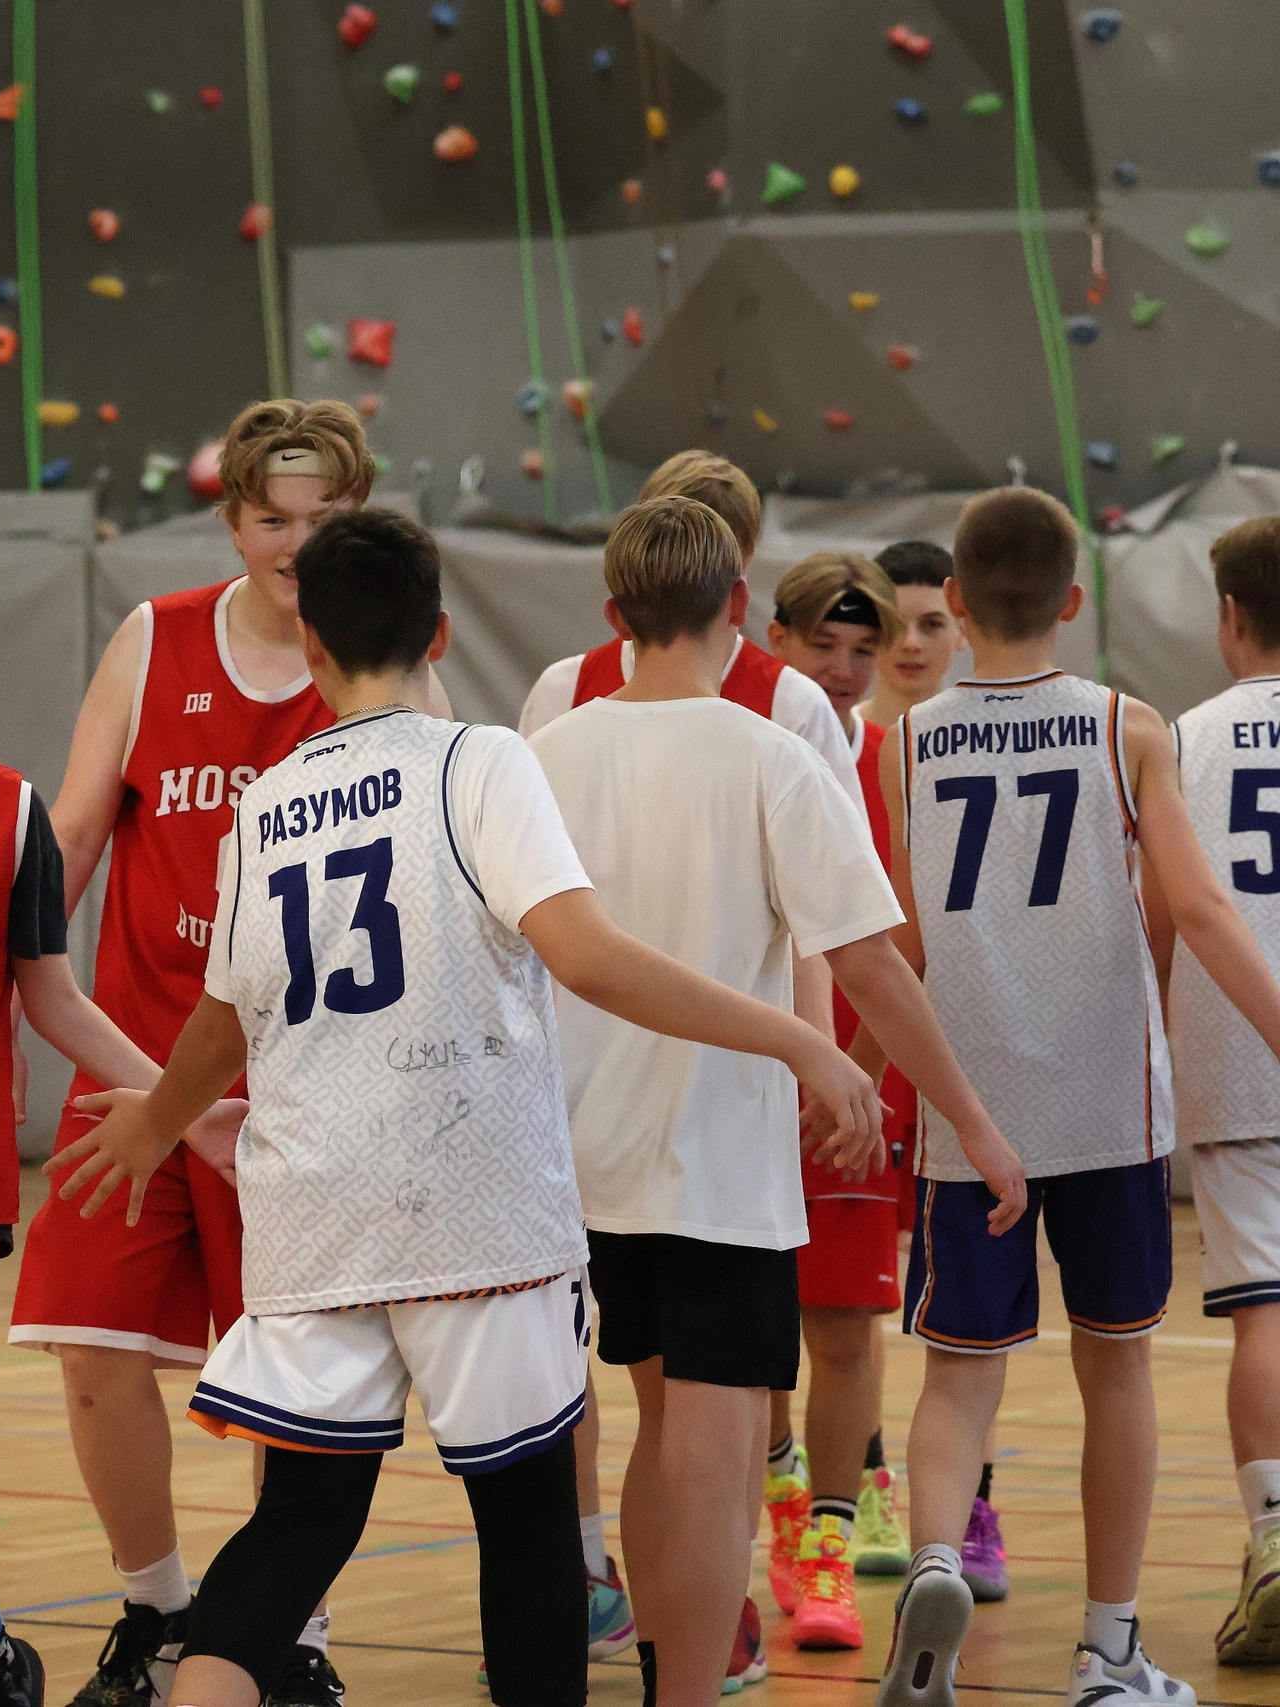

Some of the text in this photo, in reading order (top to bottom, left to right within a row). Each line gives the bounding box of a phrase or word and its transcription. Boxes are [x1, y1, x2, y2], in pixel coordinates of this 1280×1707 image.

[917, 715, 1098, 764] КОРМУШКИН
[155, 765, 262, 818] MOS
[258, 767, 402, 854] РАЗУМОВ
[934, 768, 1080, 913] 77
[175, 902, 214, 948] BU
[268, 836, 406, 1027] 13
